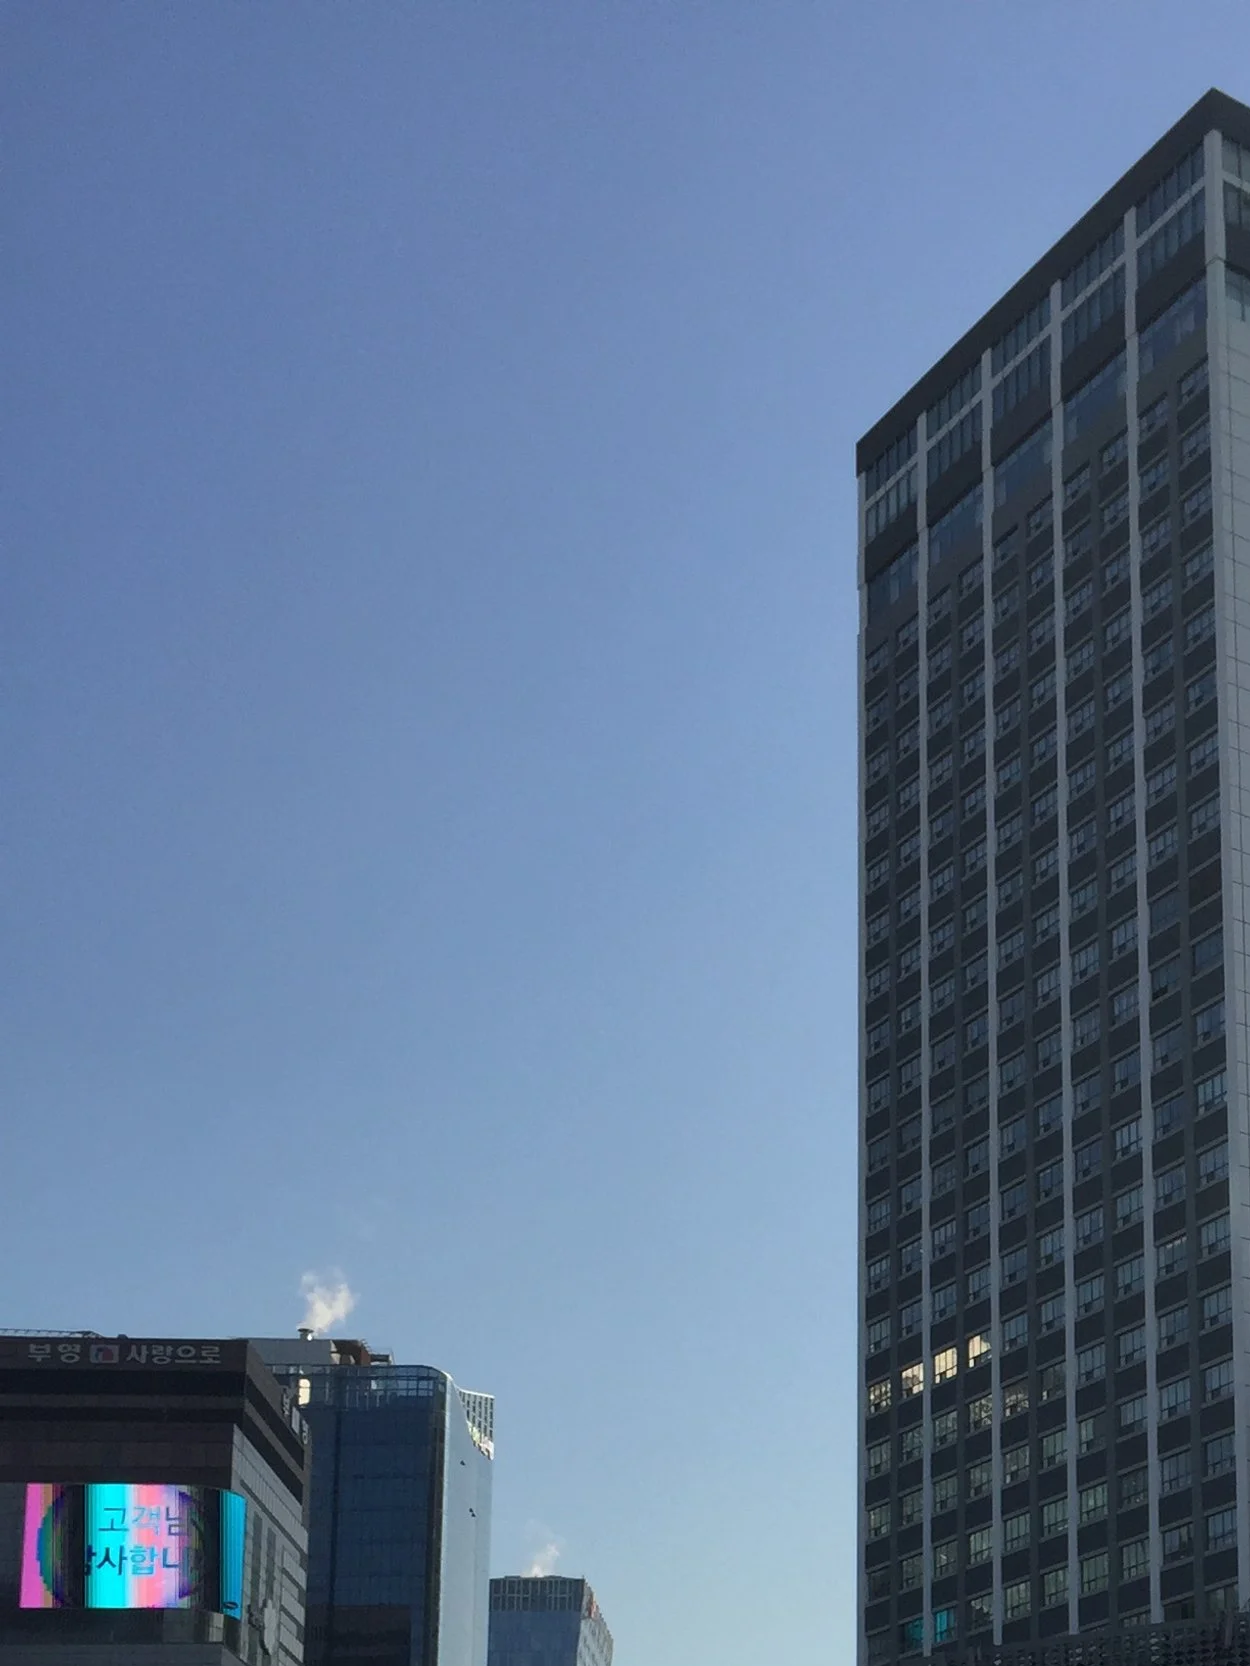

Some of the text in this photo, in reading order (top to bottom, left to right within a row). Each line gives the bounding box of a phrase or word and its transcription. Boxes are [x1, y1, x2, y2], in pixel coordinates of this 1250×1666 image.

[27, 1343, 221, 1365] 부영 사랑으로
[98, 1506, 189, 1537] 고객님
